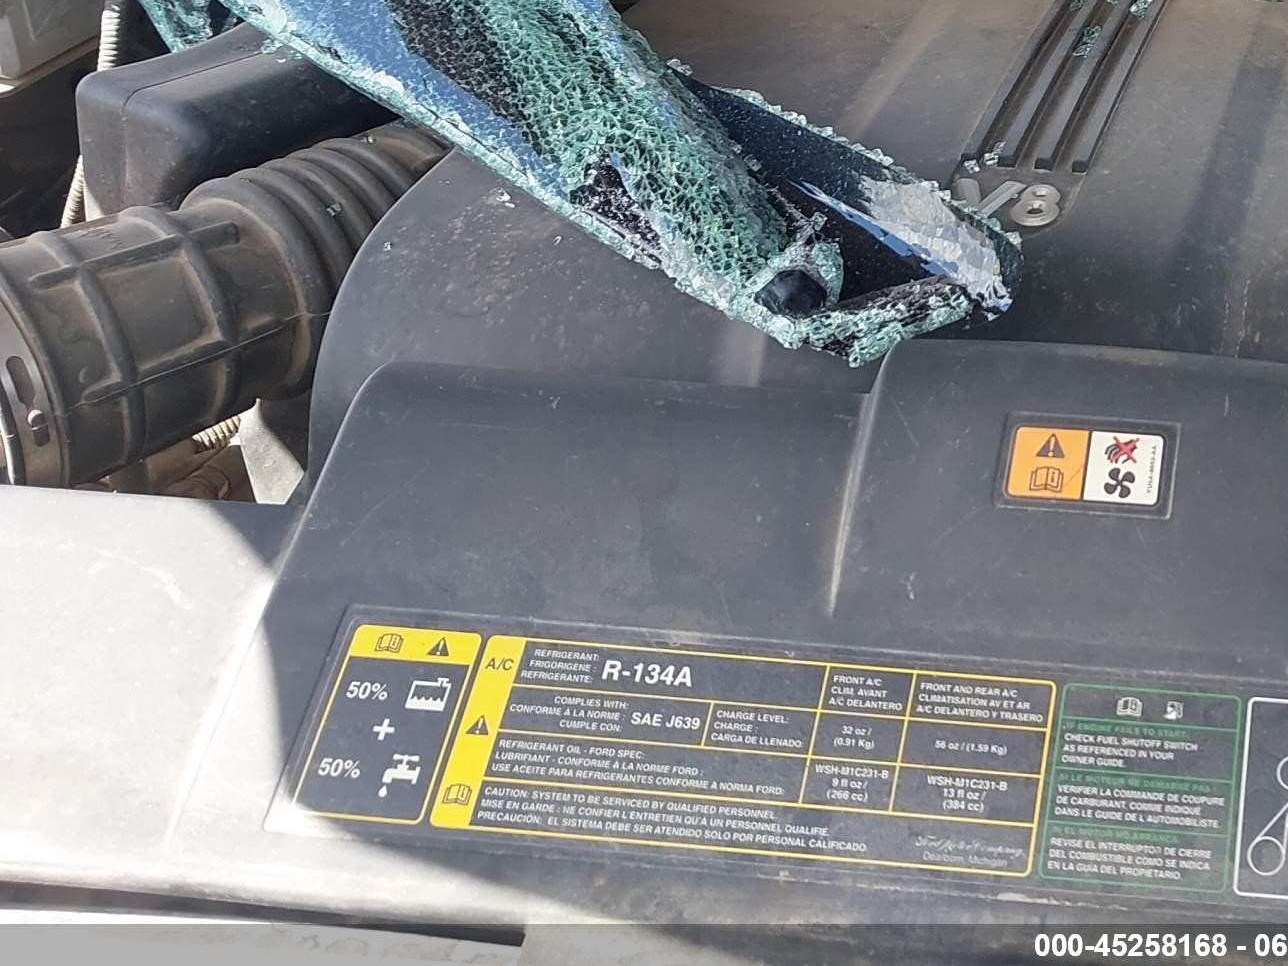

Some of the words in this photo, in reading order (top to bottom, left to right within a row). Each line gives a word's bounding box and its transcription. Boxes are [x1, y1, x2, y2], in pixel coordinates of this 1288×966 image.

[533, 648, 599, 662] REFRIGERANT:
[484, 656, 514, 671] A/C
[520, 669, 594, 683] REFRIGERANTE:
[600, 659, 695, 688] R-134A
[832, 674, 864, 685] FRONT
[866, 677, 882, 686] A/C
[346, 681, 388, 701] 50%
[857, 688, 887, 698] AVANT
[919, 682, 951, 692] FRONT
[952, 685, 973, 694] AND
[974, 687, 1000, 696] REAR
[1001, 689, 1018, 698] A/C
[553, 695, 601, 707] COMPLIES
[601, 700, 628, 709] WITH:
[828, 696, 845, 705] A/C
[846, 698, 903, 710] DELANTERO
[917, 693, 986, 706] CLIMATISATION
[988, 699, 1001, 708] AV
[1002, 700, 1014, 709] ET
[1015, 701, 1030, 710] AR
[509, 701, 562, 715] CONFORME
[572, 707, 586, 717] LA
[586, 708, 620, 720] NORME
[715, 710, 755, 721] CHARGE
[757, 713, 789, 724] LEVEL:
[915, 704, 932, 713] A/C
[933, 705, 990, 718] DELANTERO
[999, 711, 1043, 723] TRASERO
[558, 719, 597, 729] CUMPLE
[599, 722, 622, 732] CON:
[630, 711, 663, 726] SAE
[665, 714, 701, 730] J639
[713, 721, 753, 732] CHARGE
[840, 725, 853, 734] 32
[854, 726, 867, 736] oz
[498, 739, 564, 752] REFRIGERANT
[565, 745, 582, 753] OIL
[588, 747, 615, 756] FORD
[710, 732, 743, 743] CARGA
[744, 735, 757, 744] DE
[758, 736, 804, 748] LLENADO:
[317, 758, 361, 779] 50%
[494, 750, 550, 763] LUBRIFIANT
[557, 756, 610, 768] CONFORME
[621, 761, 633, 770] LA
[635, 762, 670, 773] NORME
[672, 766, 698, 776] FORD
[491, 762, 511, 771] USE
[512, 764, 546, 774] ACEITE
[547, 767, 574, 777] PARA
[575, 769, 654, 784] REFRIGERANTES
[655, 777, 708, 789] CONFORME
[719, 782, 754, 793] NORMA
[755, 785, 784, 795] FORD:
[484, 786, 530, 798] CAUTION:
[532, 790, 570, 802] SYSTEM
[570, 794, 585, 803] TO
[586, 795, 601, 804] BE
[601, 796, 650, 809] SERVICED
[650, 800, 664, 810] BY
[665, 802, 716, 814] QUALIFIED
[480, 797, 504, 808] MISE
[505, 800, 520, 809] EN
[520, 801, 555, 812] GARDE
[562, 805, 576, 814] NE
[577, 806, 622, 818] CONFIER
[709, 817, 724, 827] UN
[725, 819, 782, 832] PERSONNEL
[547, 815, 560, 825] EL
[561, 816, 603, 829] SISTEMA
[604, 820, 632, 831] DEBE
[632, 822, 653, 833] SER
[654, 824, 702, 838] ATENDIDO
[703, 829, 731, 840] SOLO
[732, 831, 754, 842] POR
[754, 833, 807, 847] PERSONAL
